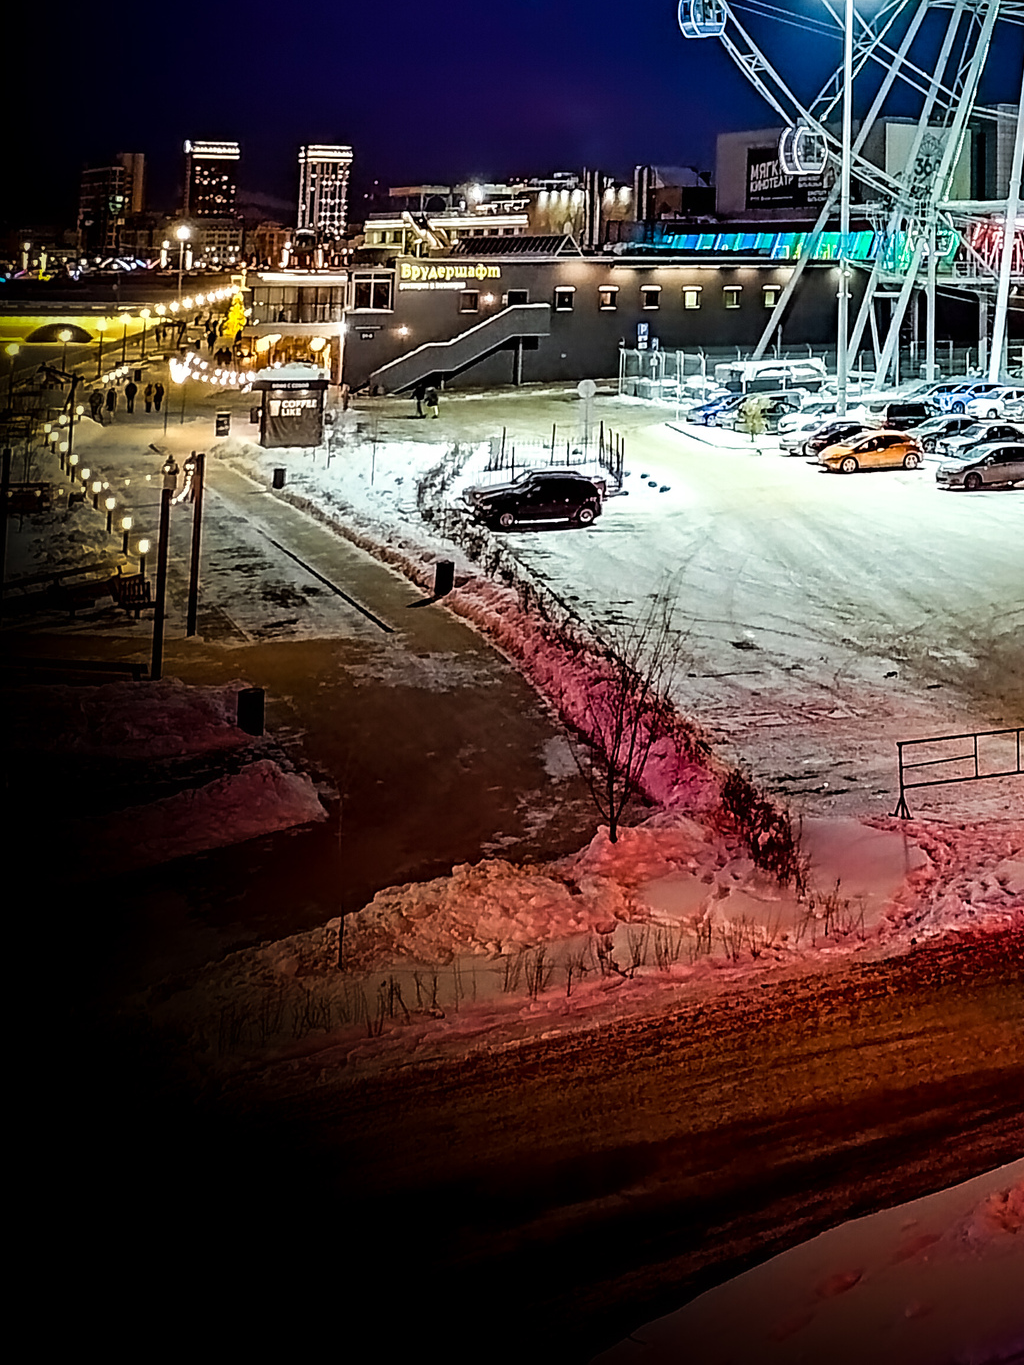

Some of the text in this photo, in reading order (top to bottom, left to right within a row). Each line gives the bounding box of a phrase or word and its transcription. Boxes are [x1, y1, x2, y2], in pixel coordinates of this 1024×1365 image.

[750, 160, 784, 181] МЯГК
[750, 175, 794, 193] КИНОТЕАТР
[401, 263, 501, 281] Брудершафт
[281, 399, 318, 409] COFFEE
[281, 408, 302, 417] LIKE
